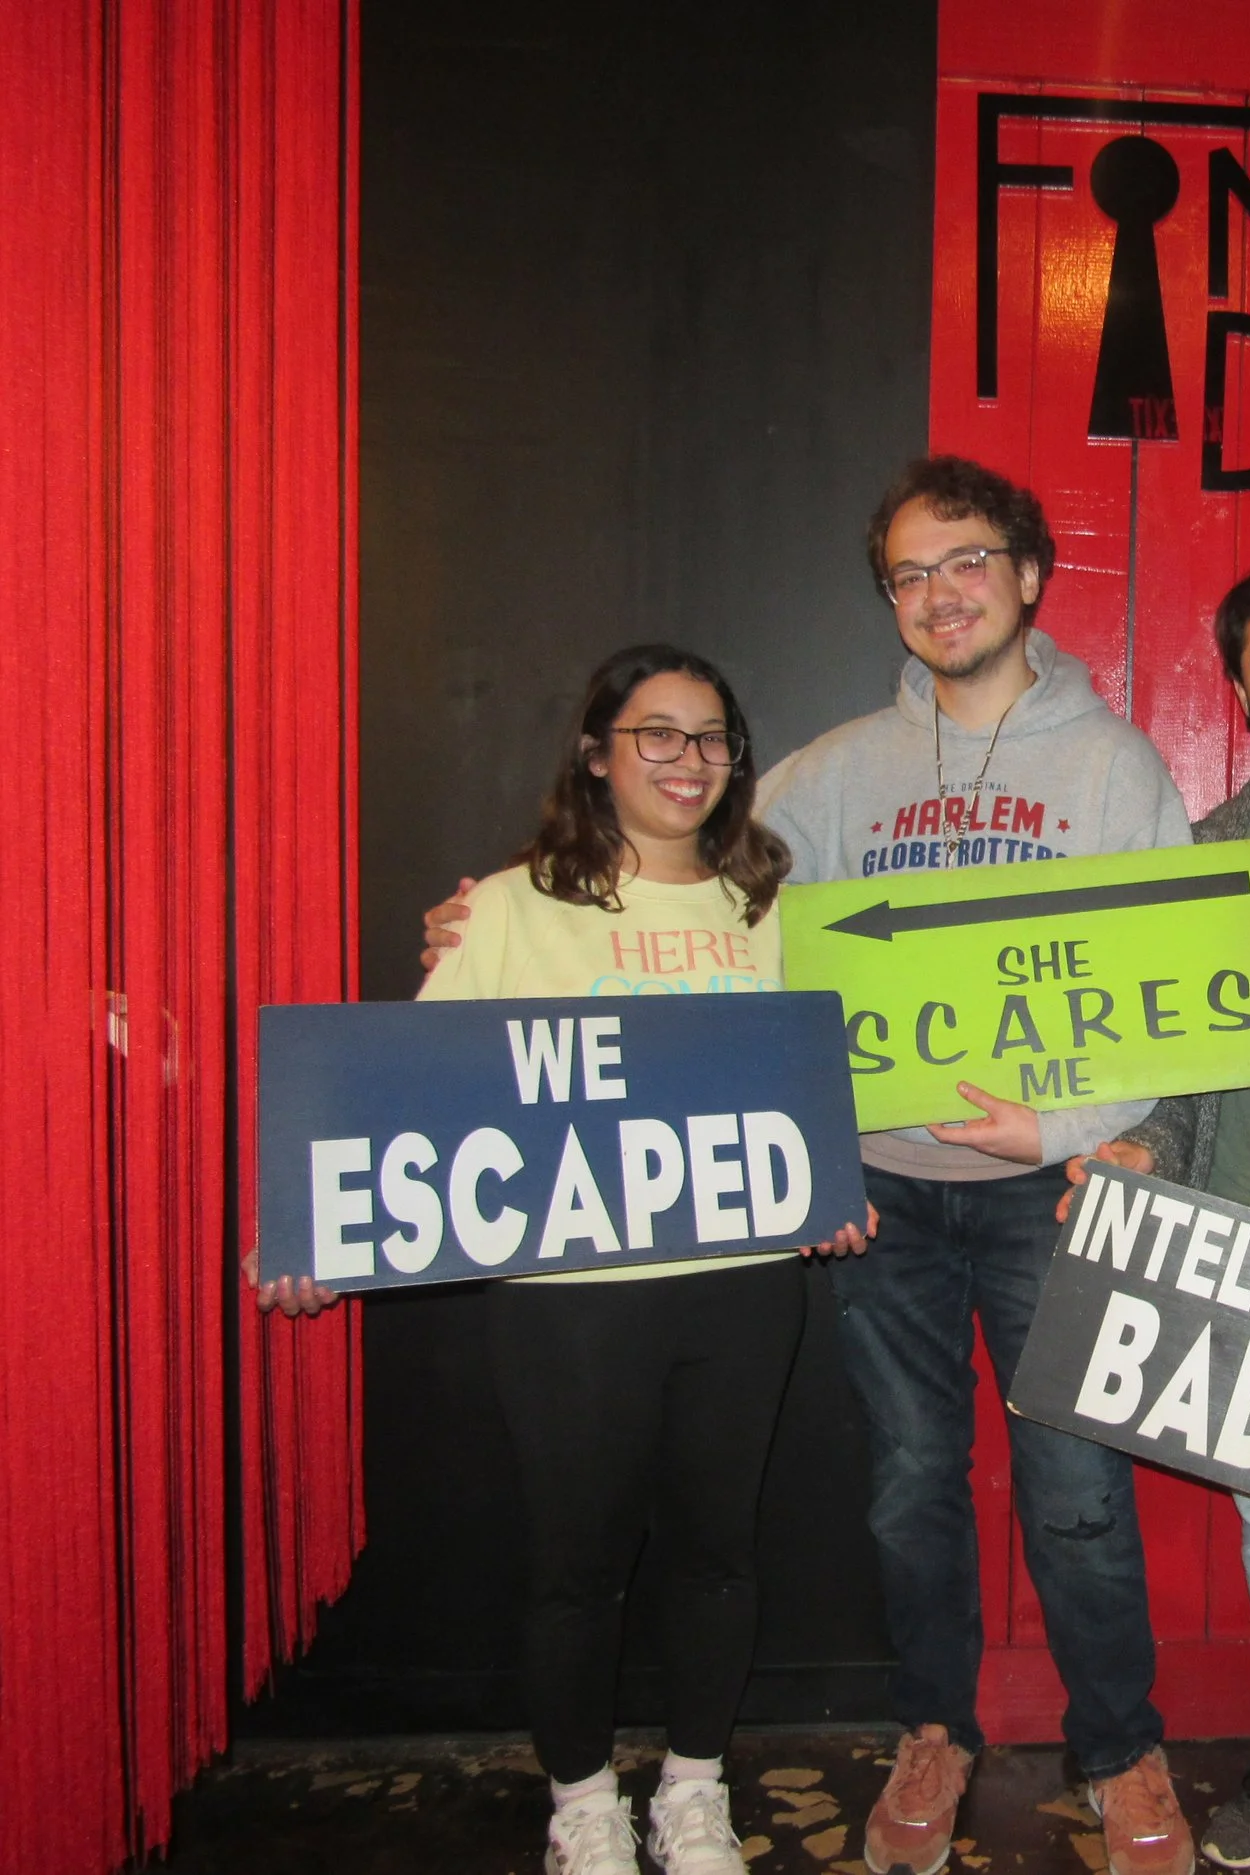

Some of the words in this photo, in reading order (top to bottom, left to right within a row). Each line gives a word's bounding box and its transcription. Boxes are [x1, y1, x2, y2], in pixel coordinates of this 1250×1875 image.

[961, 781, 1009, 793] ORINAL
[892, 796, 1045, 840] HARLEM
[862, 837, 1069, 877] GLOBEROTTER
[609, 930, 757, 974] HERE
[997, 940, 1092, 985] SHE
[507, 1016, 627, 1104] WE
[1019, 1057, 1095, 1102] ME
[311, 1111, 812, 1280] ESCAPED
